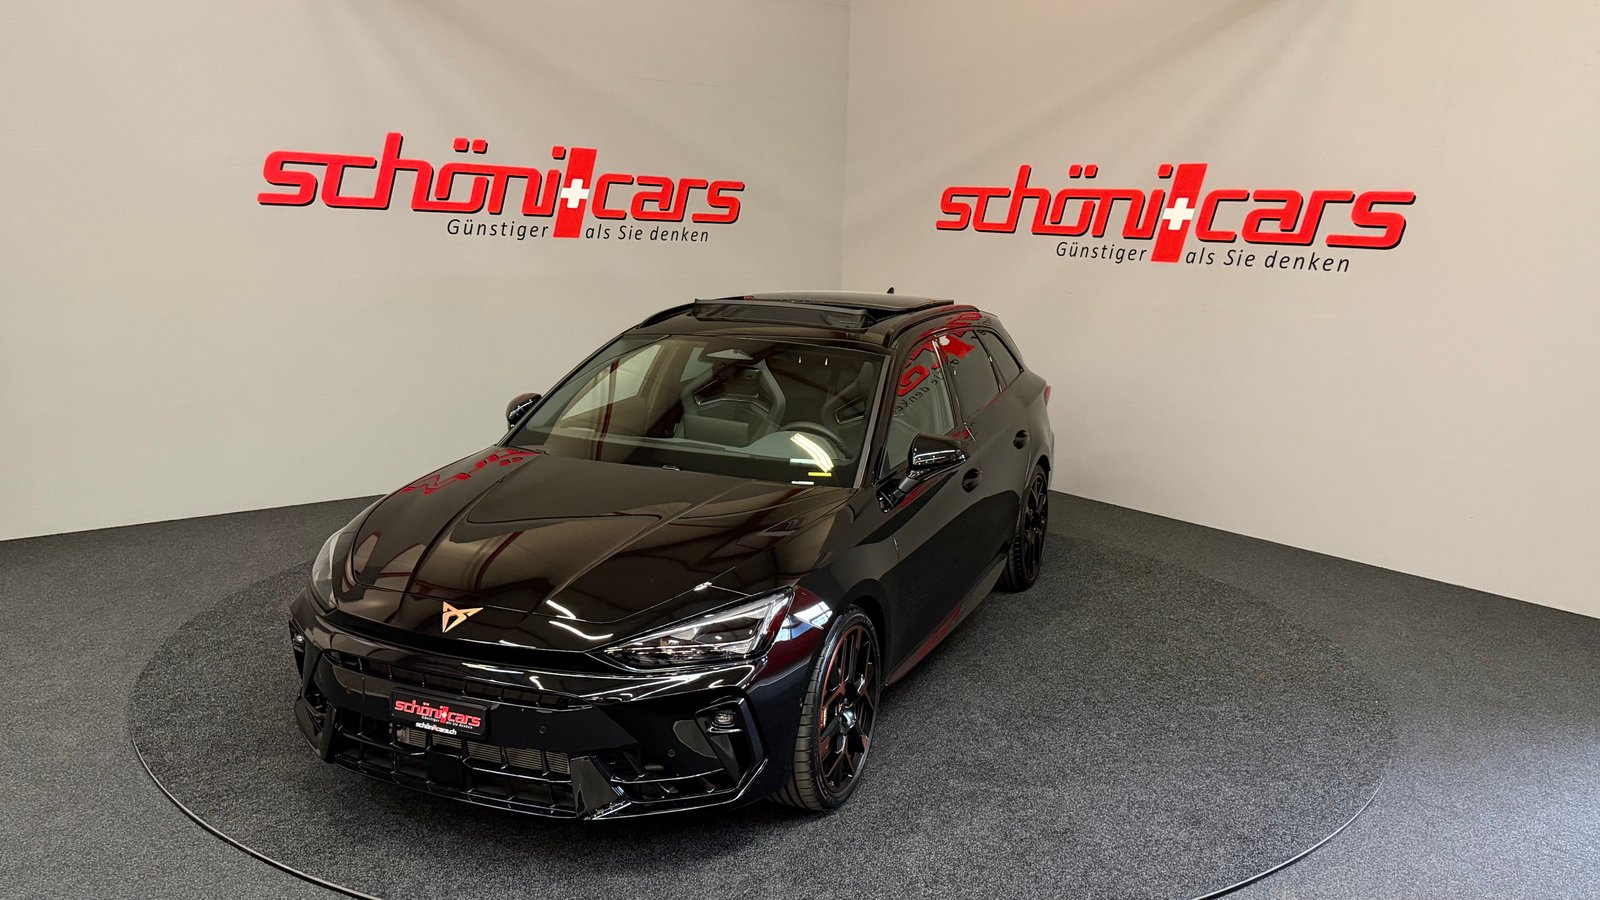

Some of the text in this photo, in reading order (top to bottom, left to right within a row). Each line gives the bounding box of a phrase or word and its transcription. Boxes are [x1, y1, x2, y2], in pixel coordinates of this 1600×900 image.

[447, 218, 709, 242] Günstiger als Sie denken
[1056, 241, 1350, 273] Günstiger als Sie denken
